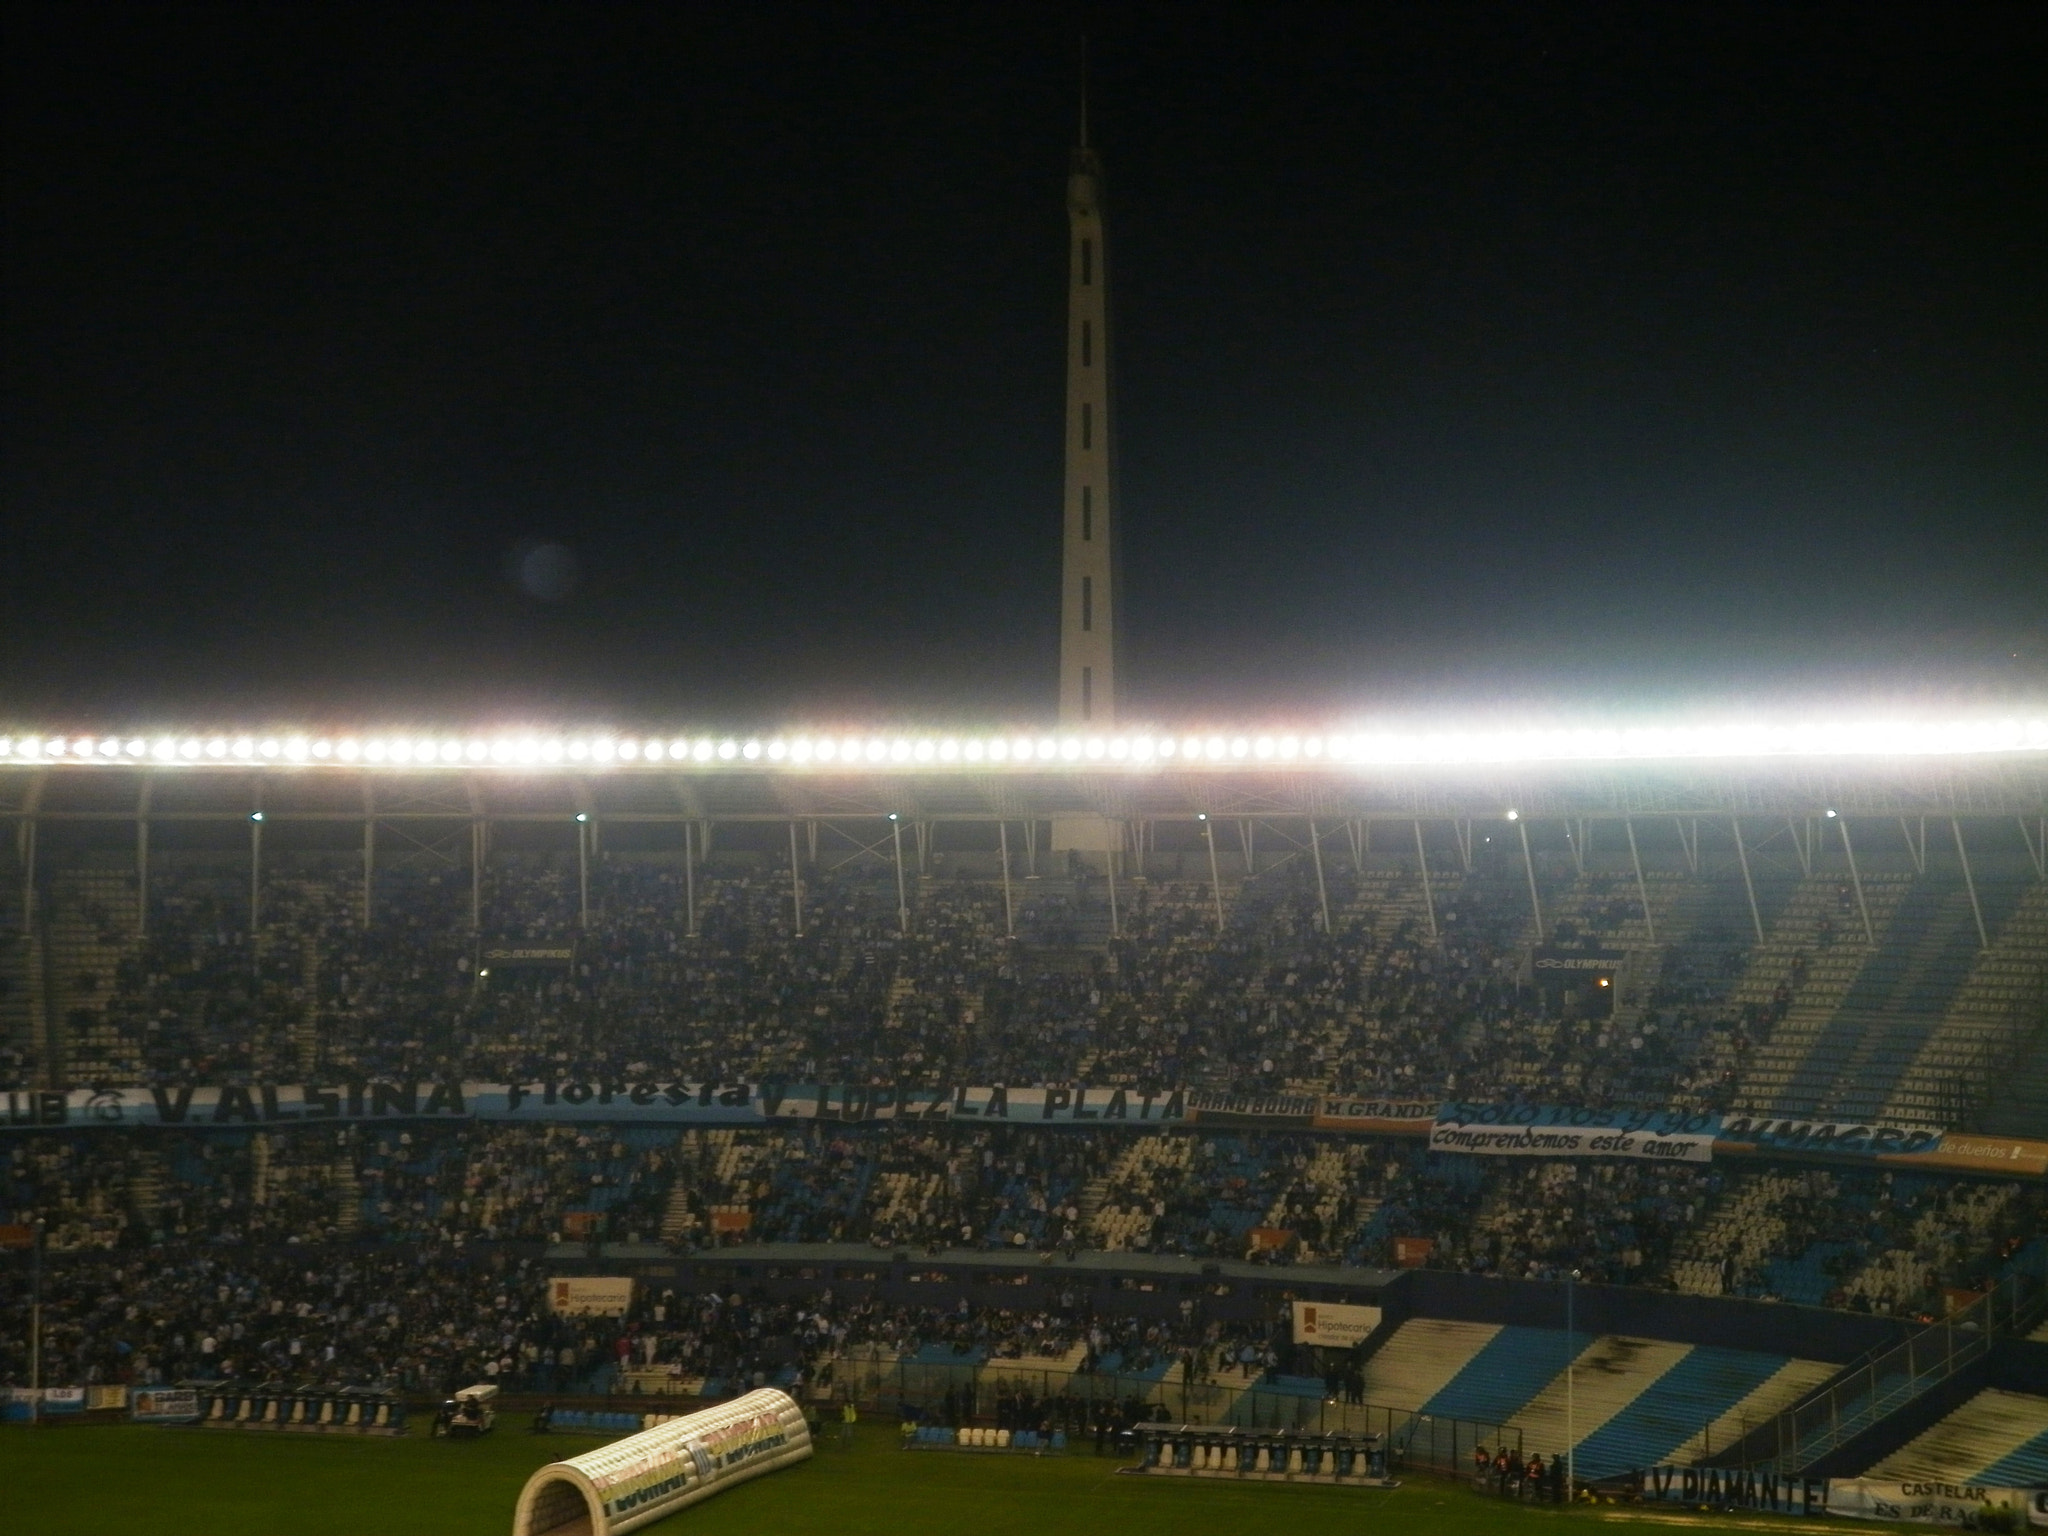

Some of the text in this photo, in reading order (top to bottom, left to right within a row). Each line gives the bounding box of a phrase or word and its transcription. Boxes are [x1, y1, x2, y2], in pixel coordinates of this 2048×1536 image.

[1564, 958, 1624, 969] OLYMPIKUS
[955, 1085, 1185, 1119] LA PLATA
[1348, 1102, 1439, 1118] GRANDE
[1589, 1133, 1635, 1151] este
[1642, 1139, 1699, 1157] amor
[1958, 1142, 2007, 1158] dueños
[1318, 1321, 1372, 1335] Hipotecario
[1902, 1483, 1986, 1501] CASTELAR
[1875, 1502, 1900, 1518] ES
[1911, 1503, 1934, 1518] DE
